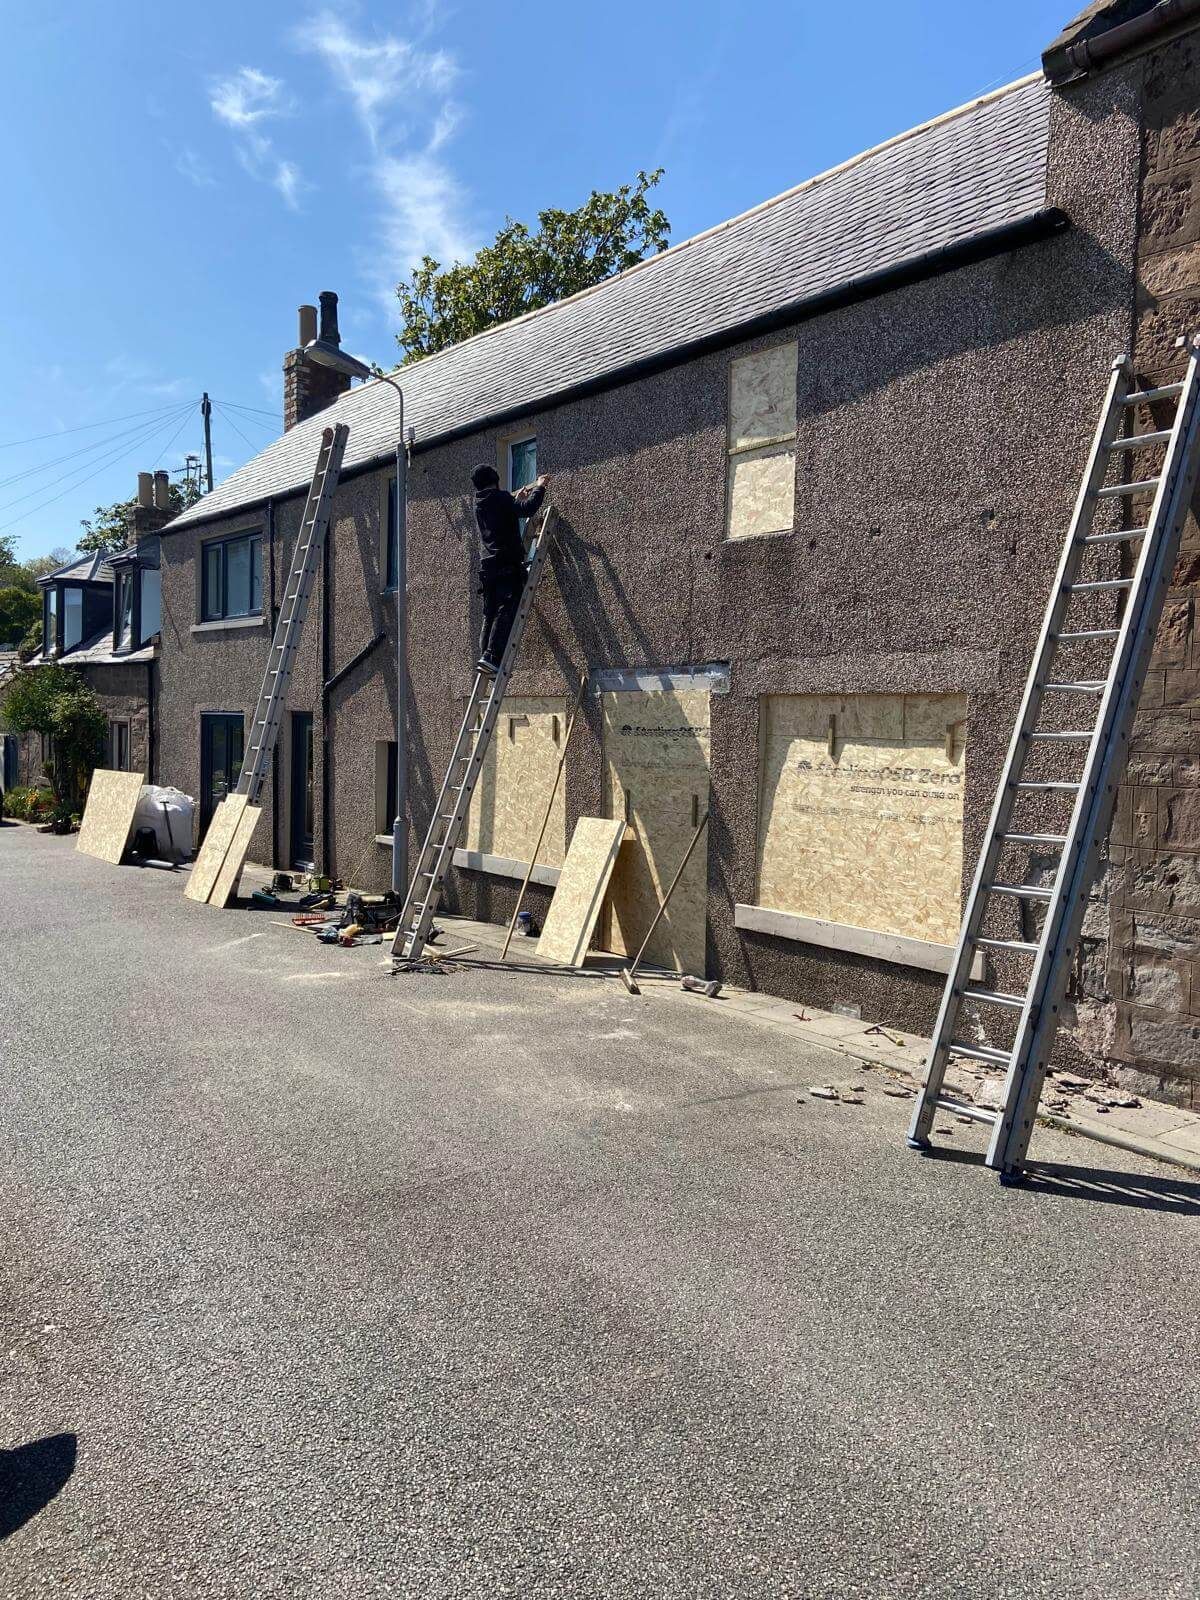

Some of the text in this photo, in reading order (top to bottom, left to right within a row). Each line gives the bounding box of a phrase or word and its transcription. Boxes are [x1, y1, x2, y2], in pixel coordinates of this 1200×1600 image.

[918, 768, 962, 785] Zero
[886, 788, 903, 797] you
[904, 789, 920, 798] can
[947, 792, 960, 800] on
